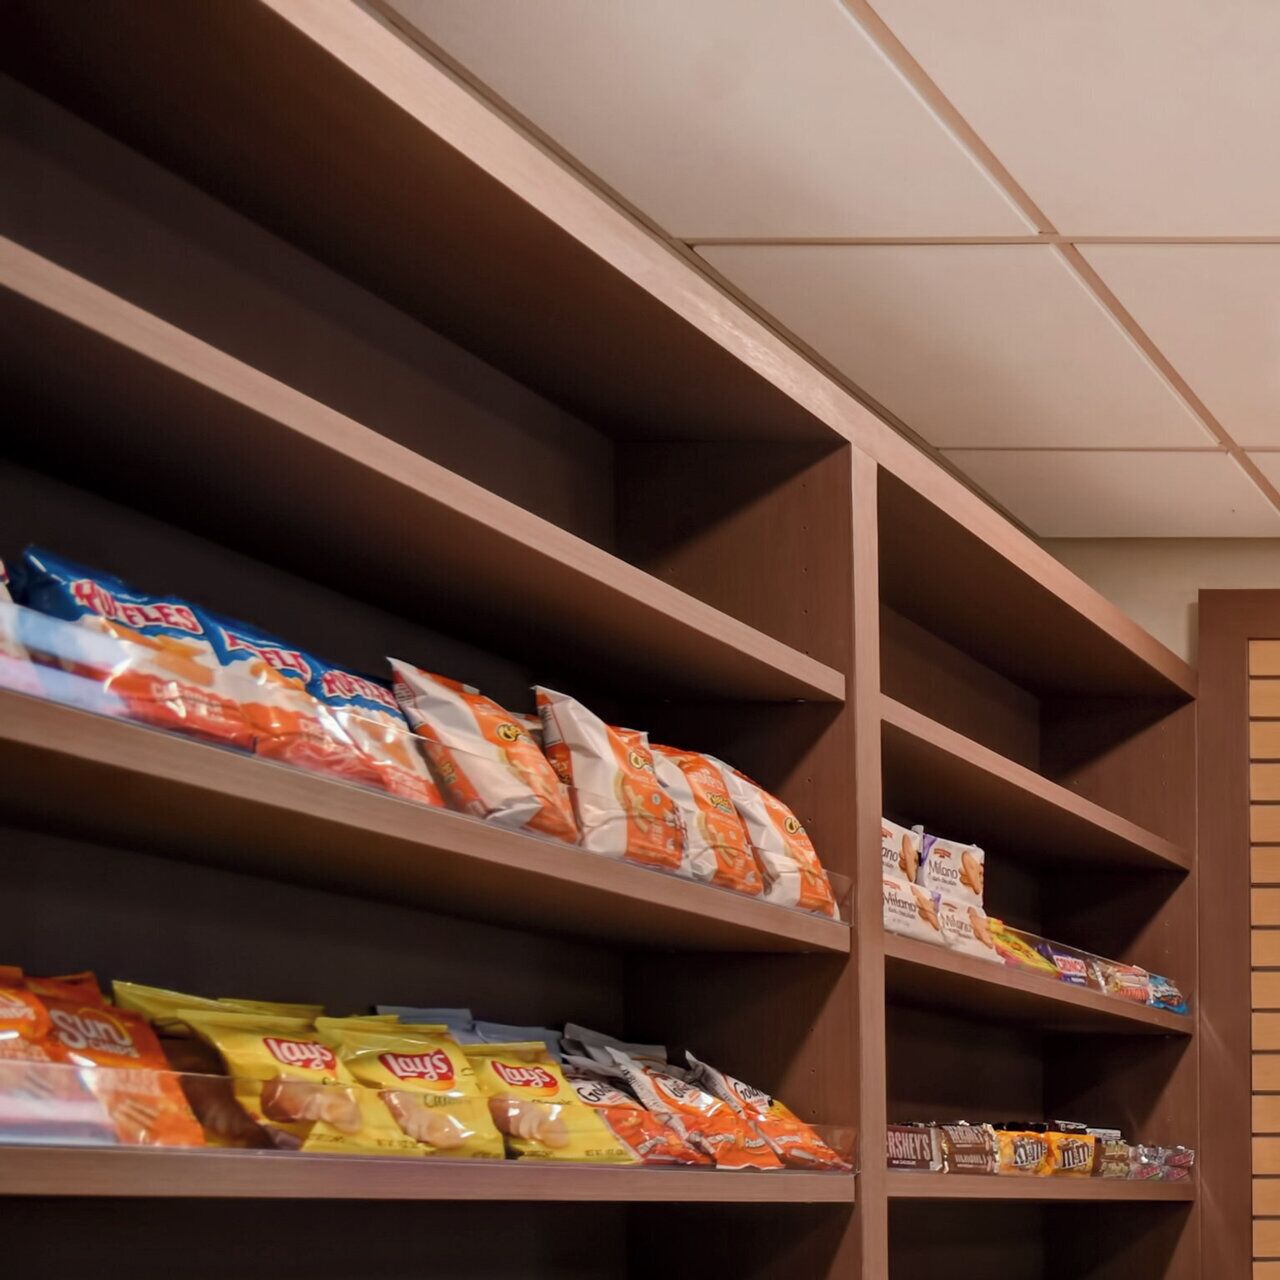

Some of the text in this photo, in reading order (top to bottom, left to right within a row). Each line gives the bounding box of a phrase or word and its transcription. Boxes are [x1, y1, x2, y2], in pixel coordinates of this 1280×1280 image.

[71, 579, 204, 635] RUFFLES
[928, 860, 959, 881] Milano
[50, 1009, 132, 1049] Sun
[268, 1037, 335, 1071] Lay's
[390, 1049, 450, 1082] Lay's
[499, 1061, 549, 1088] Lay's
